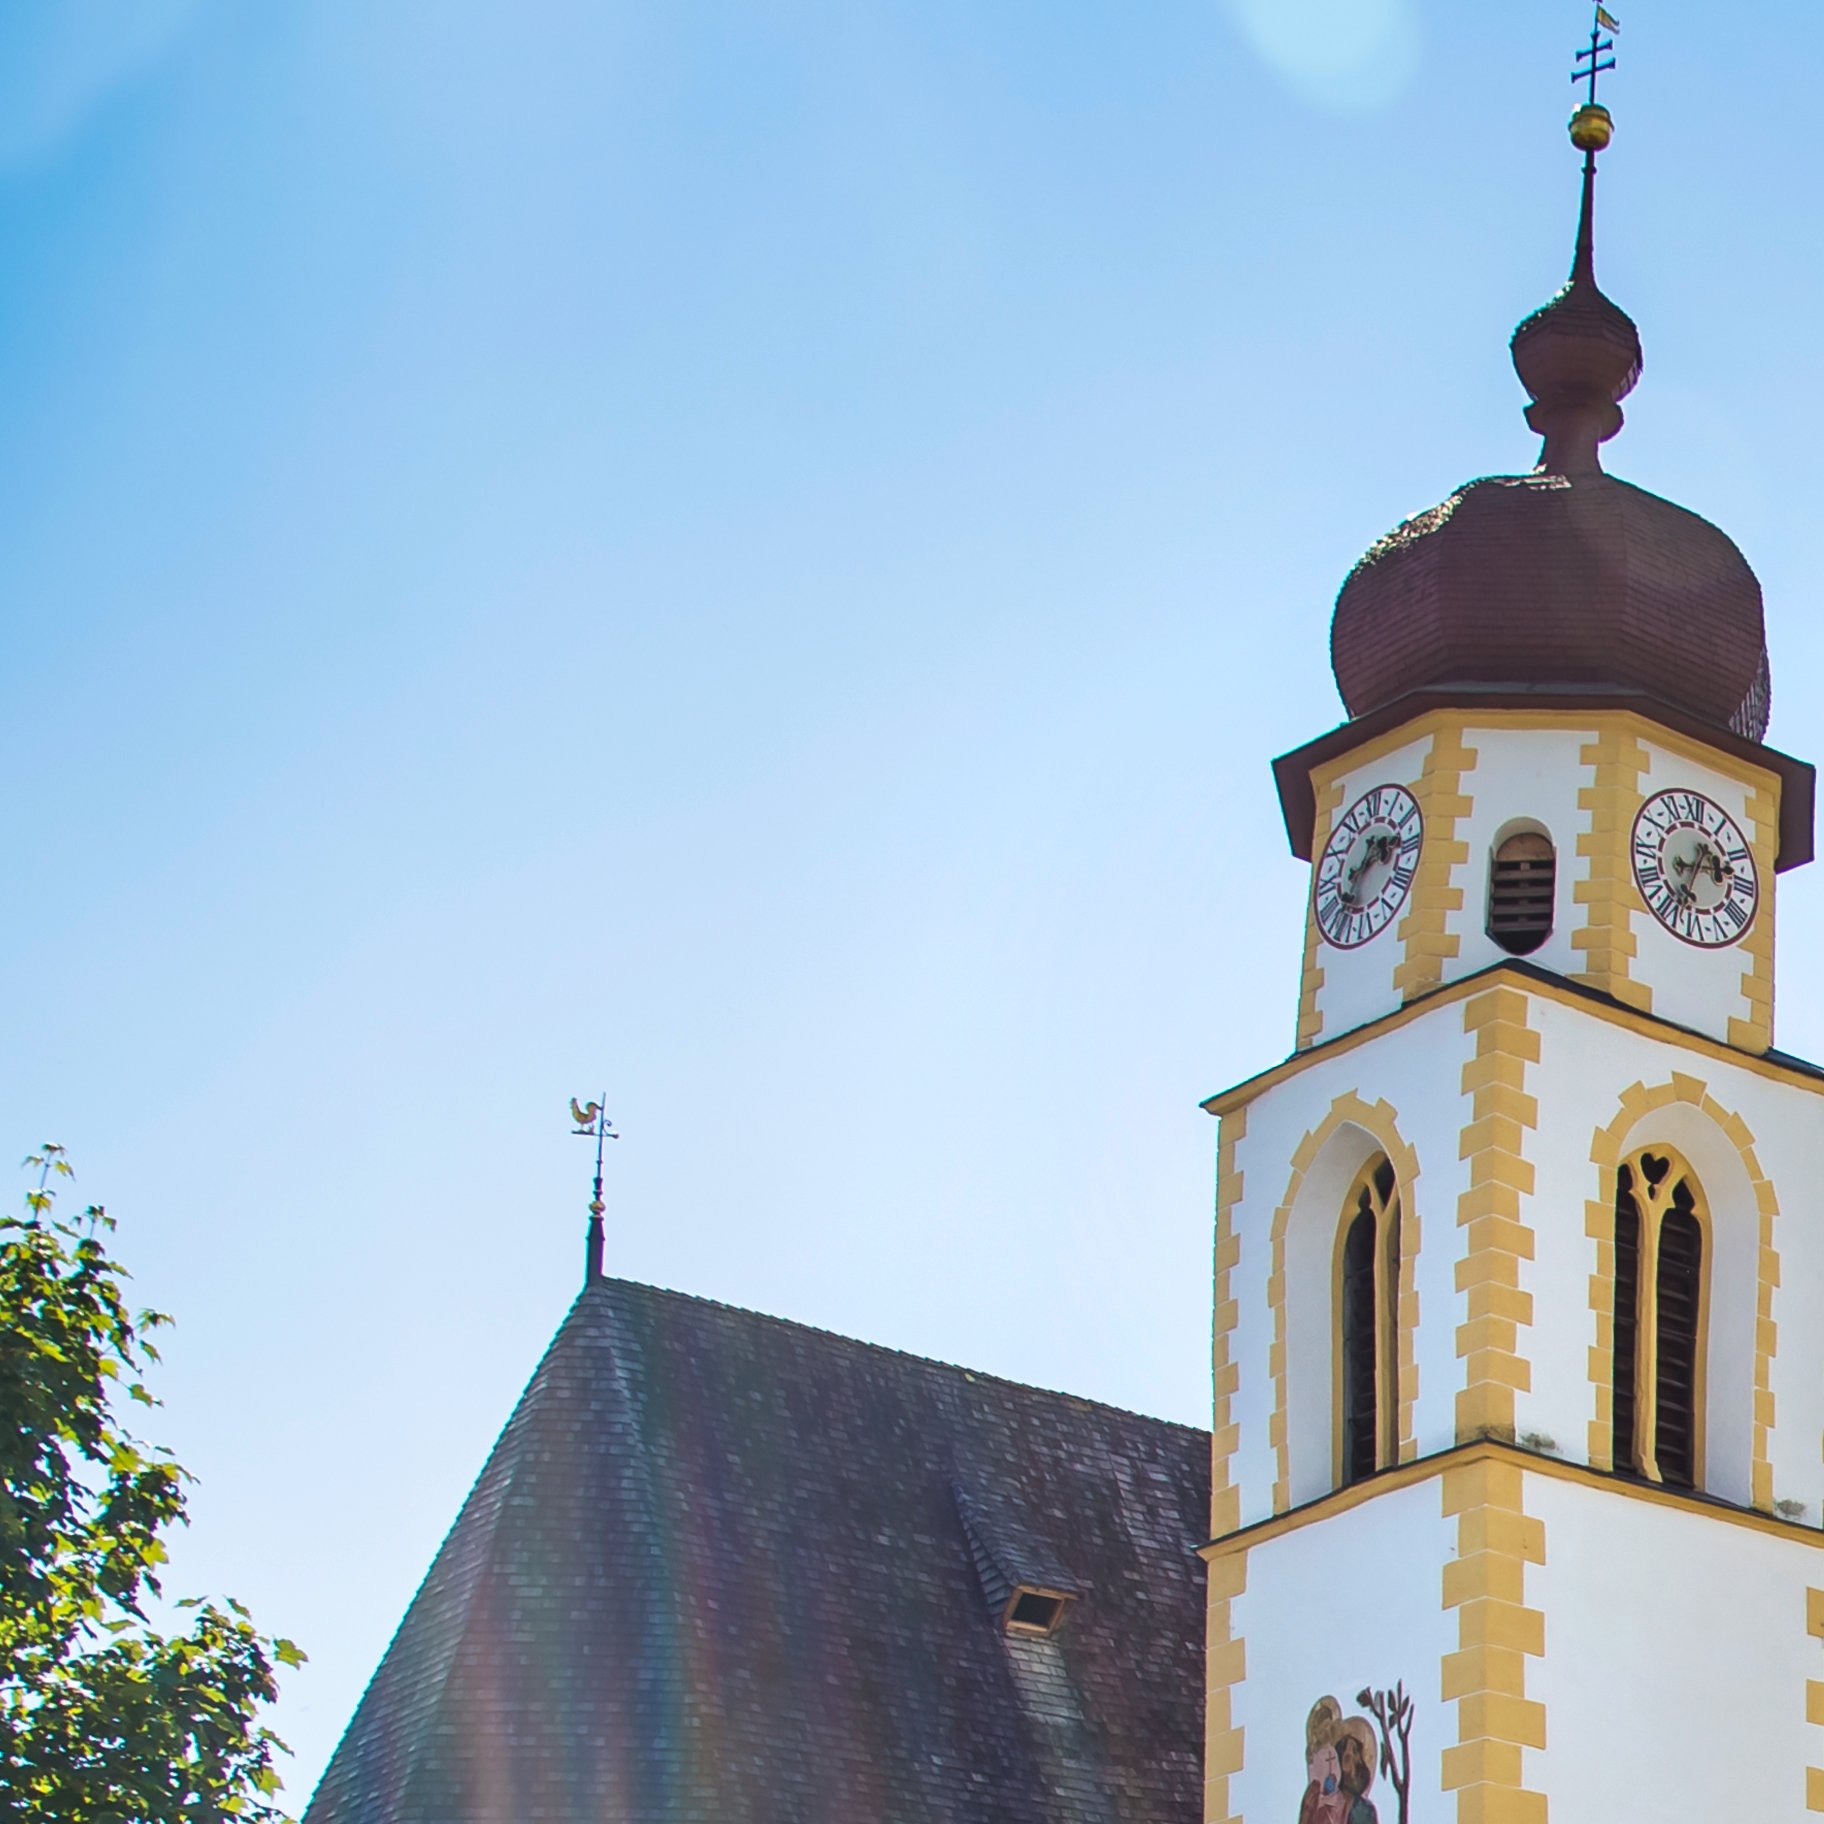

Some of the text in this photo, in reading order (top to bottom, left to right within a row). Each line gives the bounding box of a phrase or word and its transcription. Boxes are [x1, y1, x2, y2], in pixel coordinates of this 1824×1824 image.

[1684, 795, 1706, 824] XII
[1727, 848, 1748, 861] II
[1734, 874, 1755, 898] III
[1724, 898, 1748, 929] IIII
